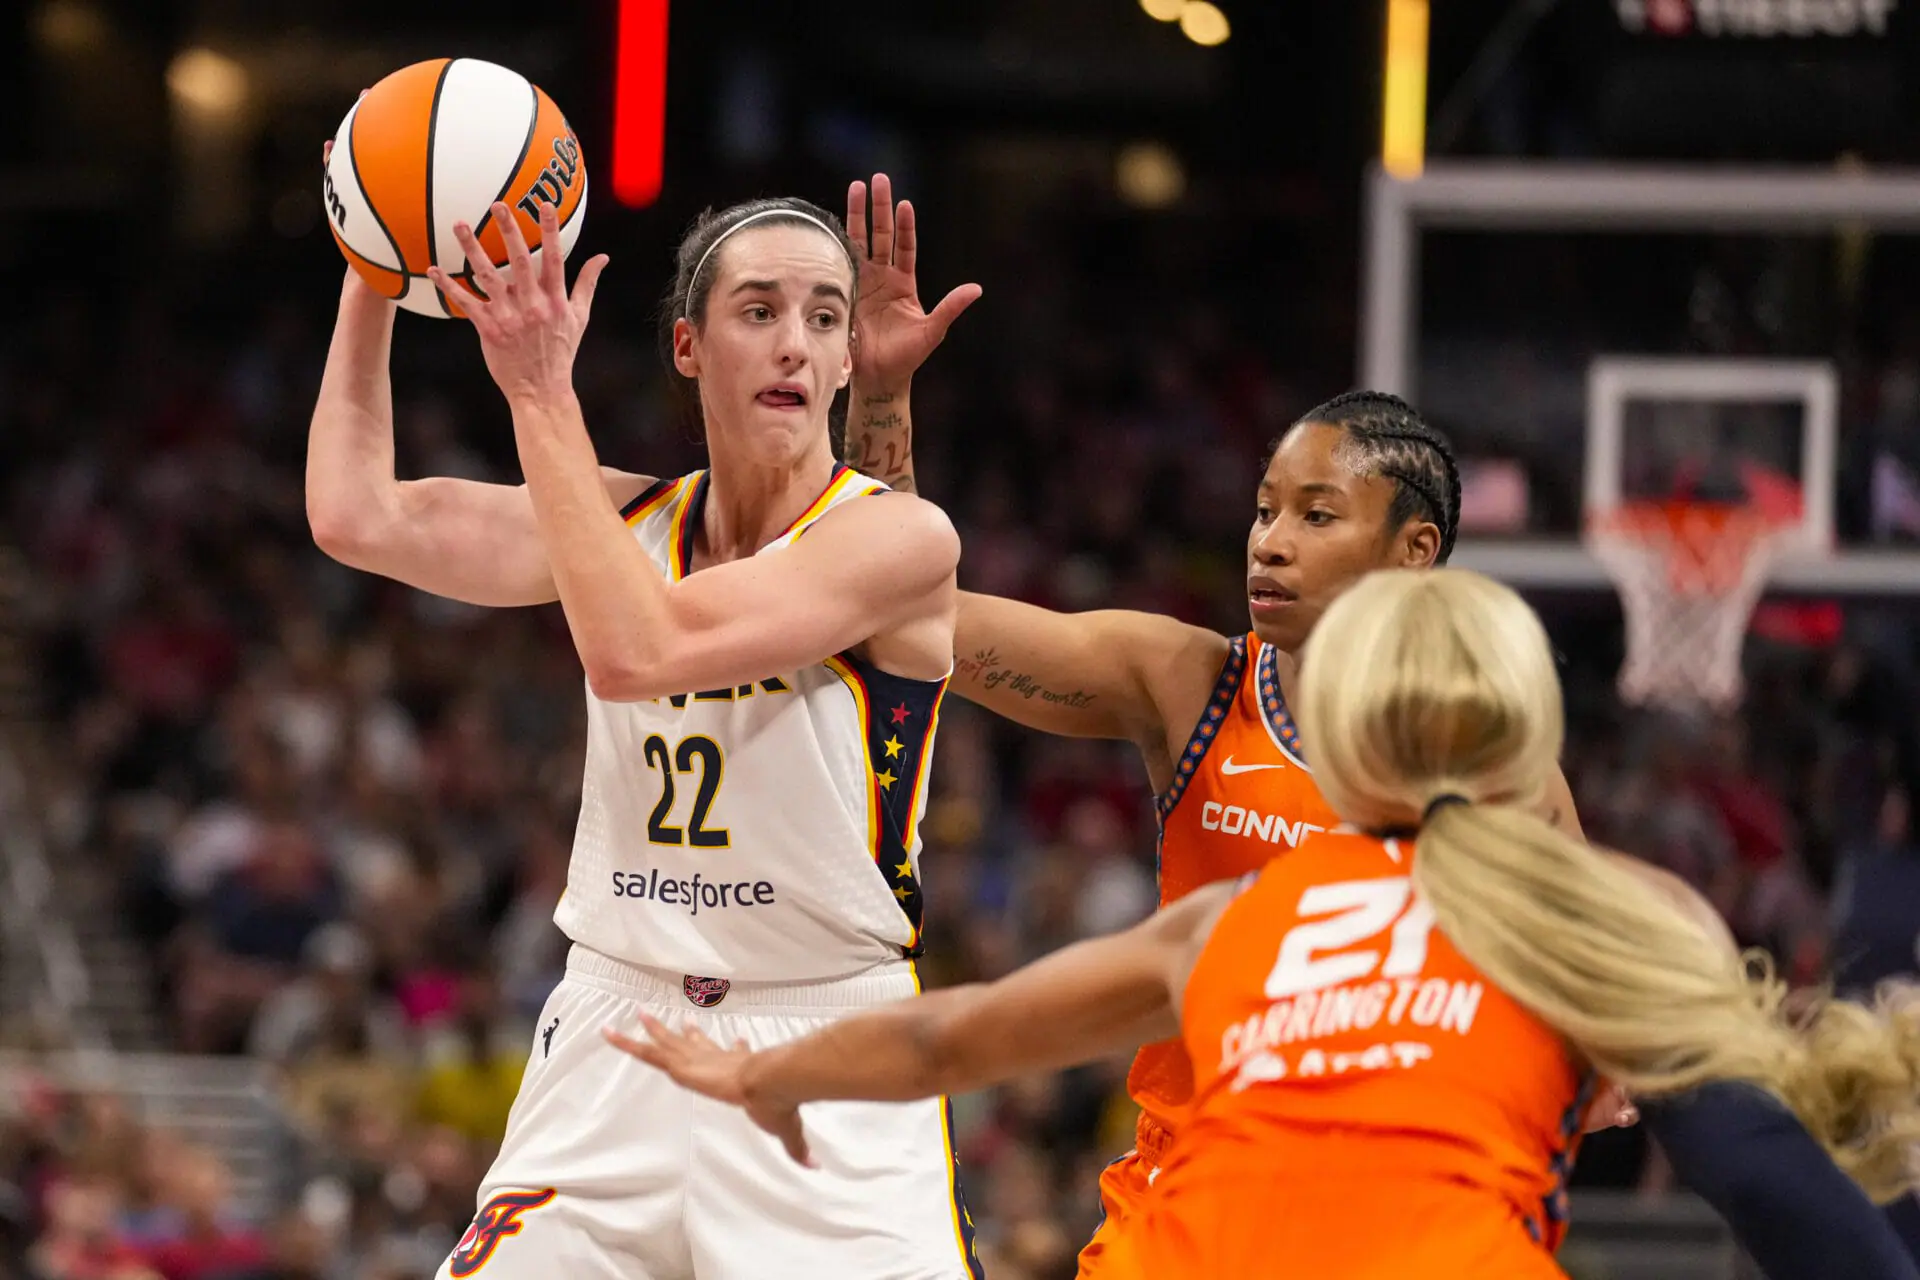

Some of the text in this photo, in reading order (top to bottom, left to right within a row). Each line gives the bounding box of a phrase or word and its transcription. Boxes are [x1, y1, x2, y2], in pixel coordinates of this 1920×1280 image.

[643, 733, 731, 849] 22
[612, 868, 776, 916] salesforce
[1265, 876, 1438, 999] 21
